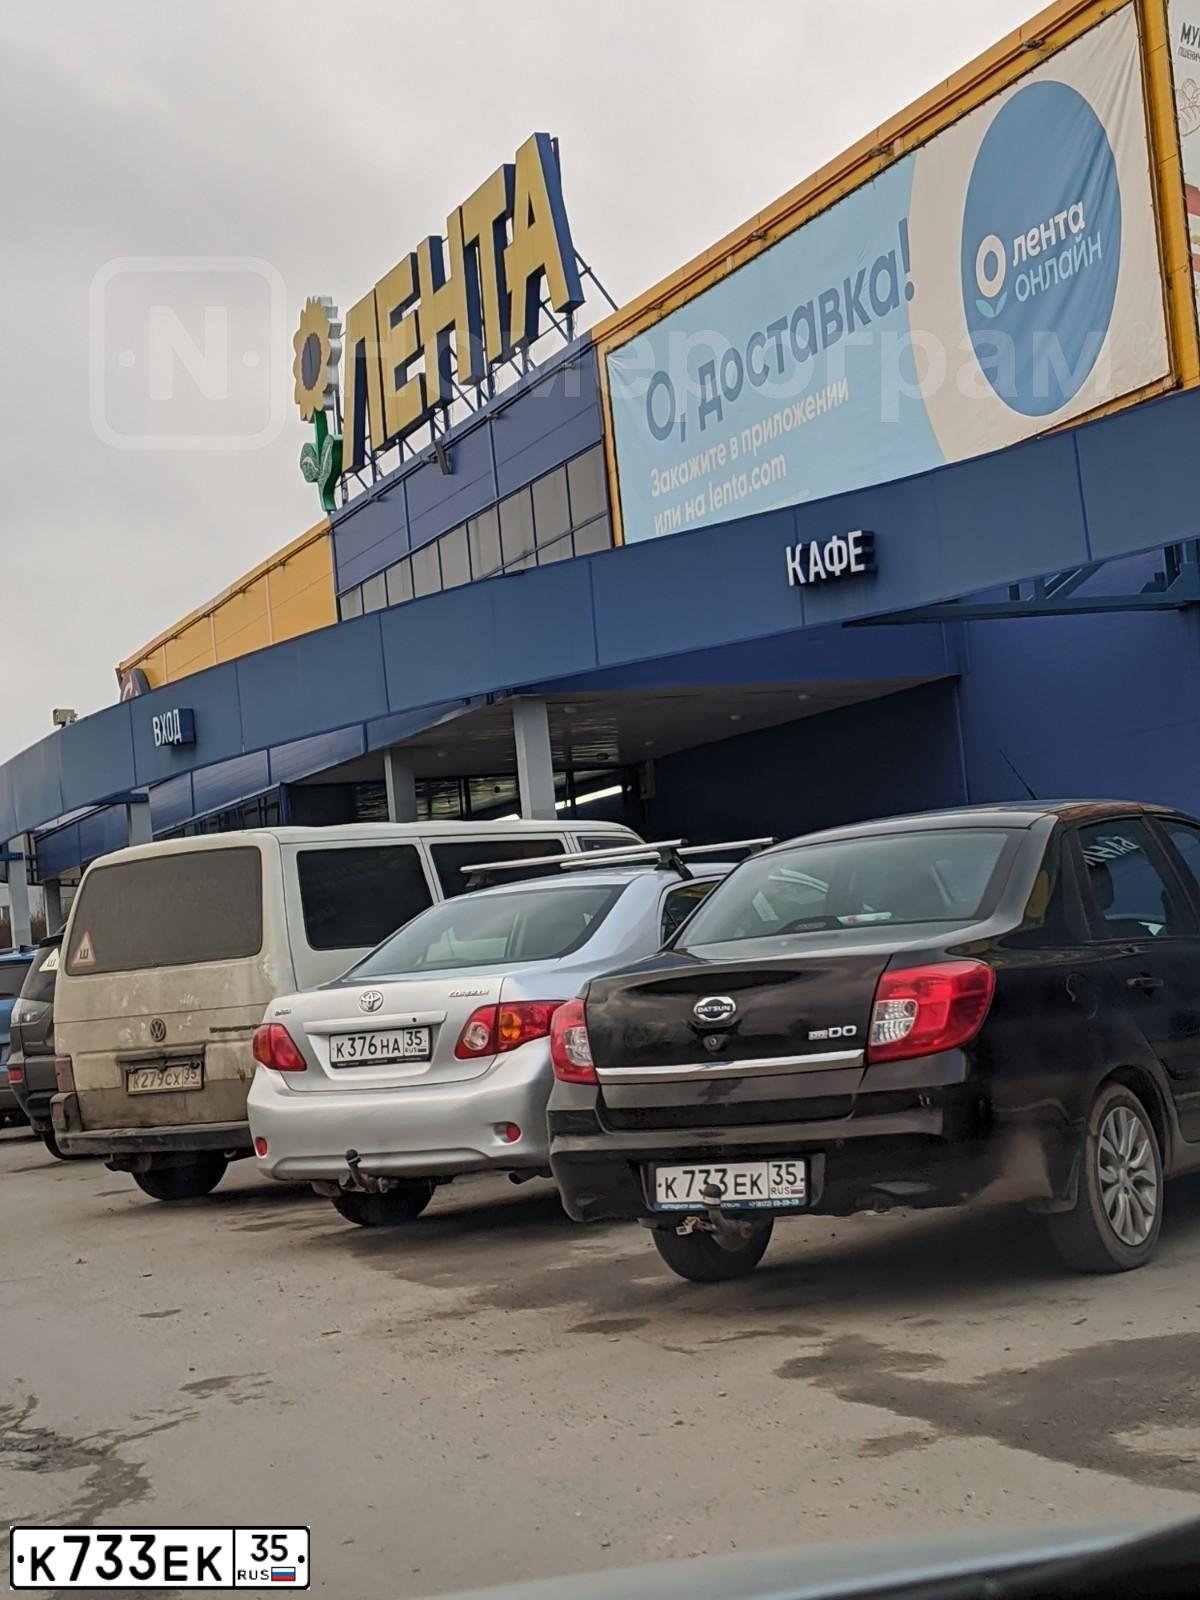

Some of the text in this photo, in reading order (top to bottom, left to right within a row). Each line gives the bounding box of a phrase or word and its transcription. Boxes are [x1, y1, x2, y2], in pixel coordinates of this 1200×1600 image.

[1013, 201, 1085, 267] лента
[1015, 231, 1102, 302] онлайн
[342, 133, 575, 473] ЛЕНТА
[697, 217, 915, 432] доставка!
[650, 376, 850, 498] Закажите в приложении
[654, 504, 682, 535] или
[684, 494, 706, 523] на
[708, 454, 788, 513] lenta.com
[785, 530, 866, 587] КАФЕ
[152, 708, 183, 748] ВХОД
[696, 1004, 732, 1014] DATSUN
[335, 1030, 423, 1060] К376НА 35
[664, 1163, 798, 1199] К733ЕК 35
[770, 1186, 790, 1196] RUS
